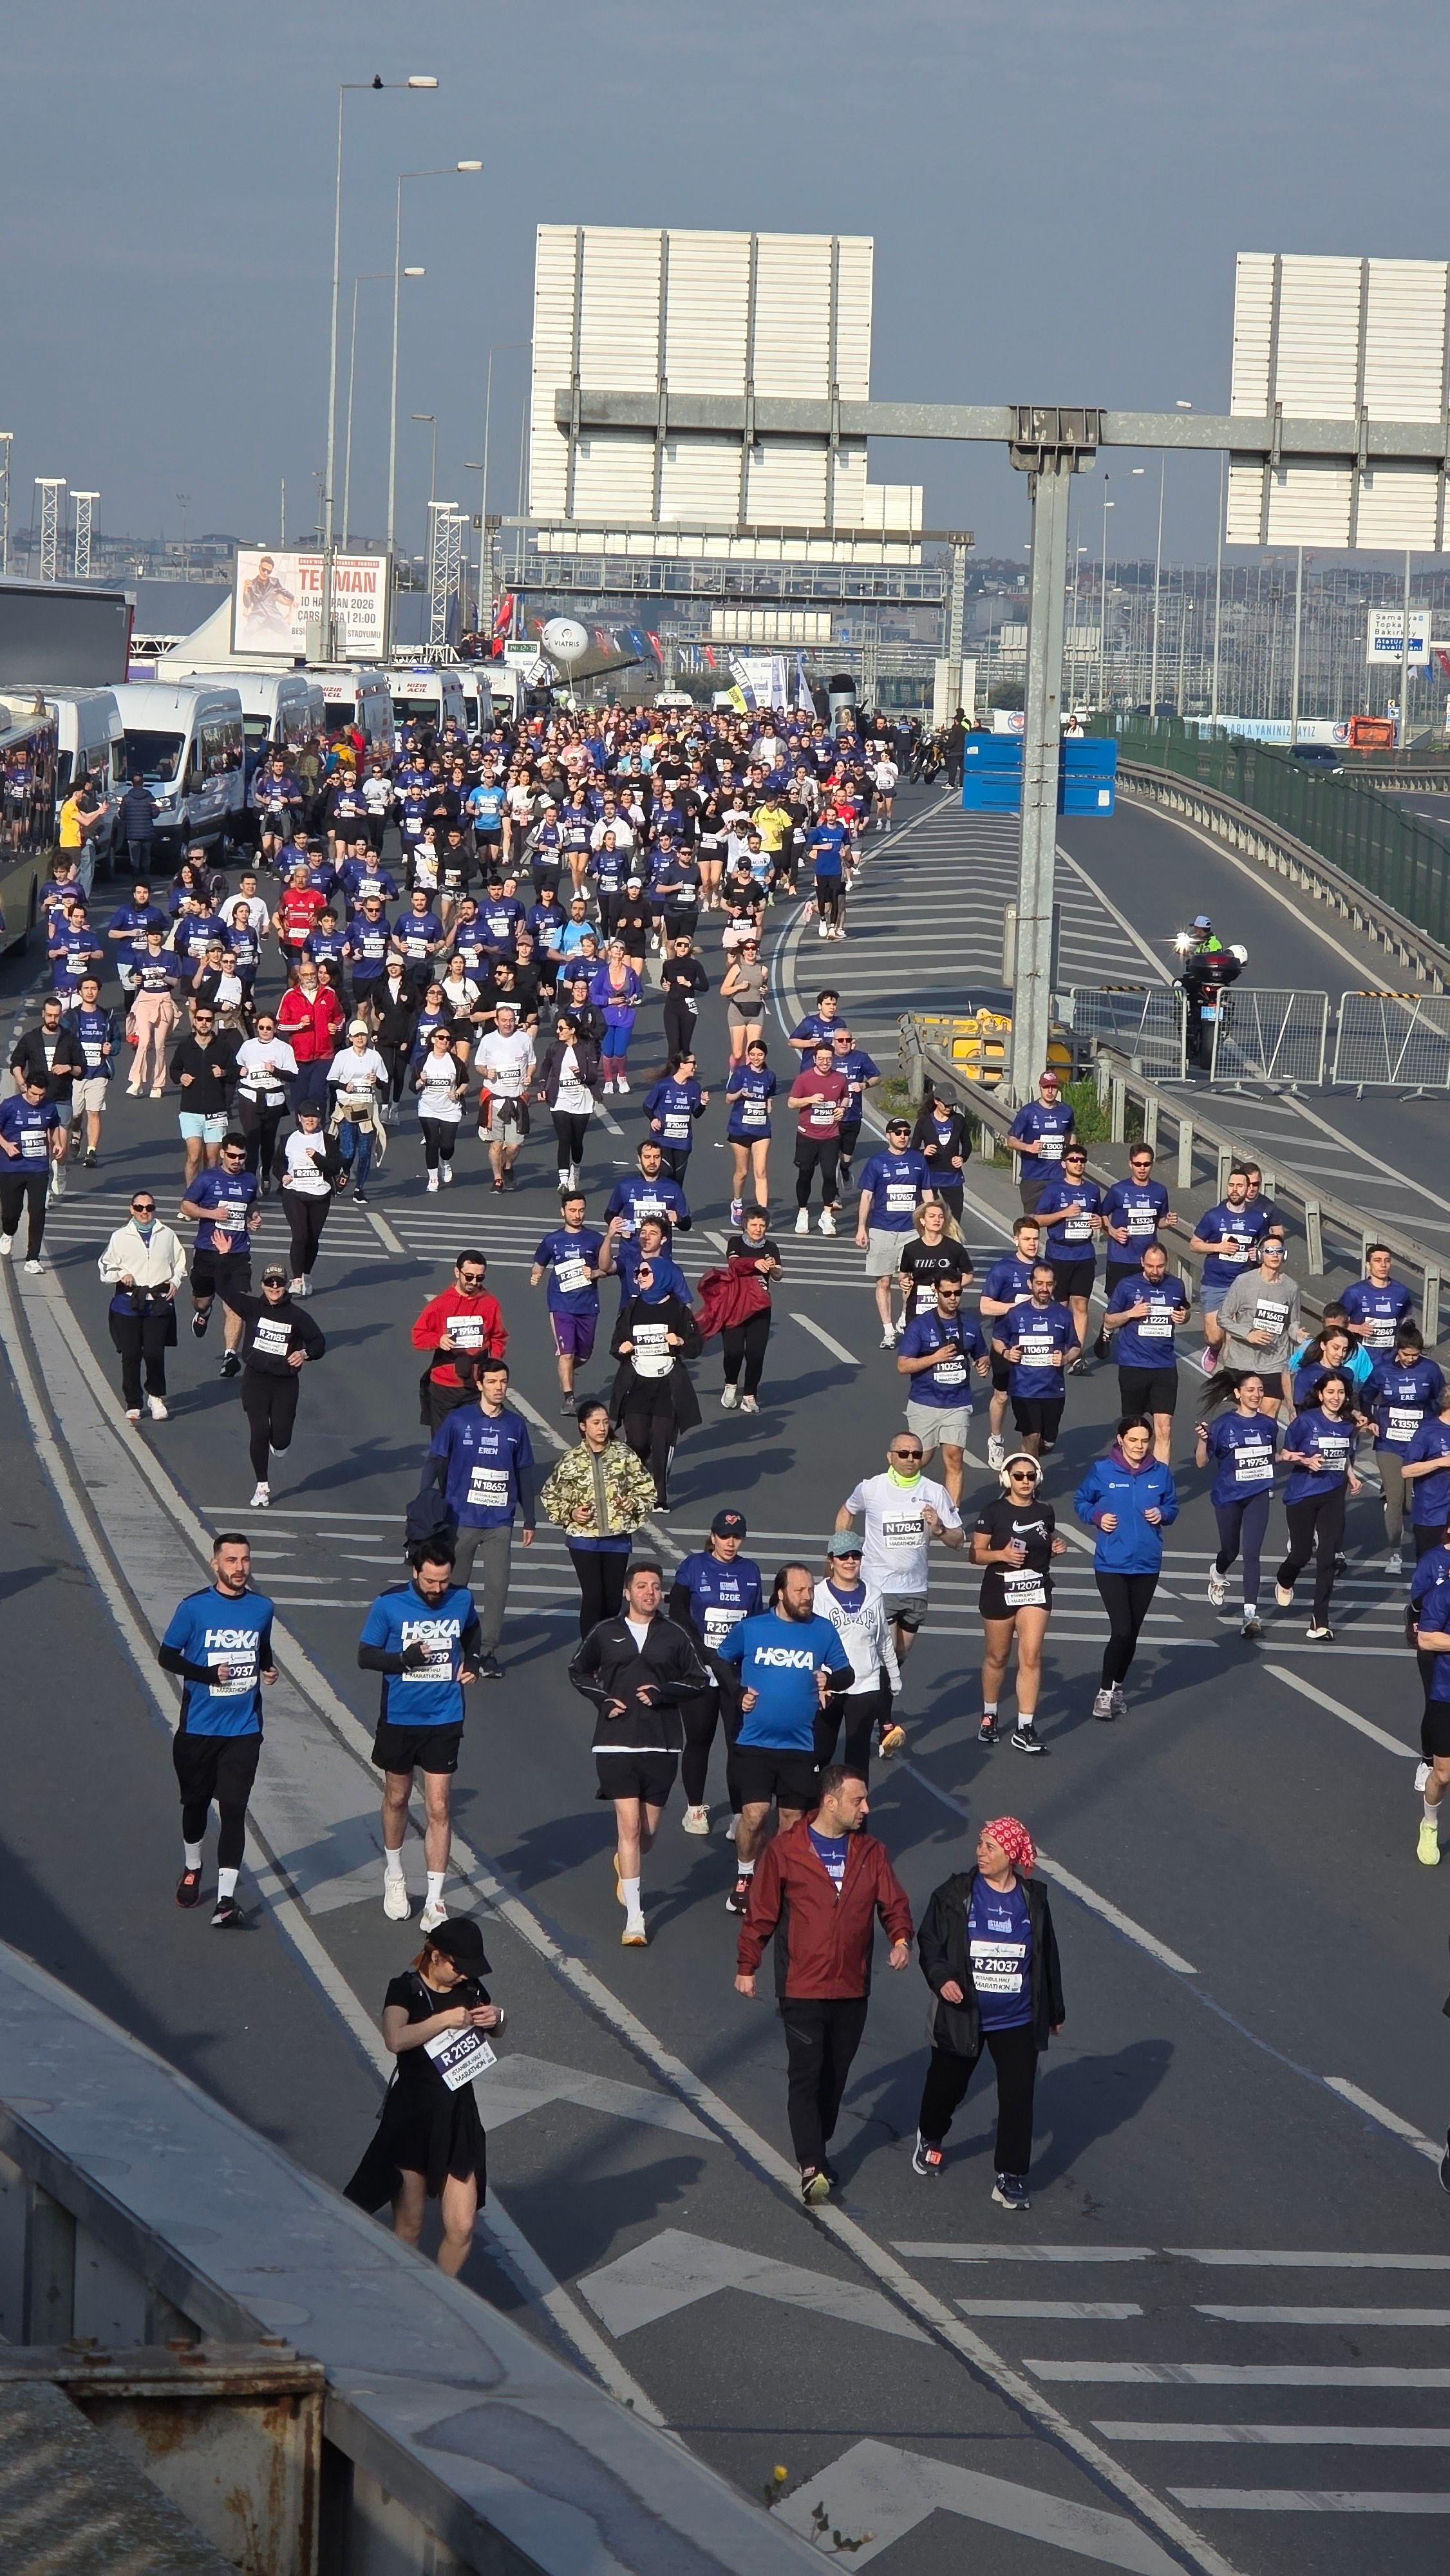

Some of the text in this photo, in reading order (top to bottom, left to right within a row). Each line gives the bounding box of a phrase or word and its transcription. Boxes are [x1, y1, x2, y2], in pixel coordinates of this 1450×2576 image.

[299, 569, 377, 593] TEMAN
[301, 596, 374, 609] 10 HARAN 2026
[352, 613, 376, 623] 21:00
[347, 630, 381, 639] STADYUMU
[1256, 724, 1316, 737] YANINIZAYIZ
[1391, 1419, 1398, 1428] K
[478, 1447, 498, 1455] EREN
[1239, 1459, 1245, 1468] P
[473, 1480, 507, 1492] N 18652
[886, 1522, 921, 1533] N 17842
[1008, 1580, 1041, 1591] J 12071
[720, 1592, 740, 1602] ÖZGE
[402, 1619, 460, 1640] HOKA
[706, 1622, 714, 1632] R
[204, 1629, 259, 1649] HOKA
[425, 1653, 449, 1663] 939
[754, 1647, 814, 1671] HOKA
[229, 1665, 254, 1677] 0937
[974, 1958, 1019, 1973] R 21037
[975, 1982, 1010, 1991] MARATHON
[440, 2033, 481, 2067] R 21351
[455, 2058, 487, 2084] MARATHON
